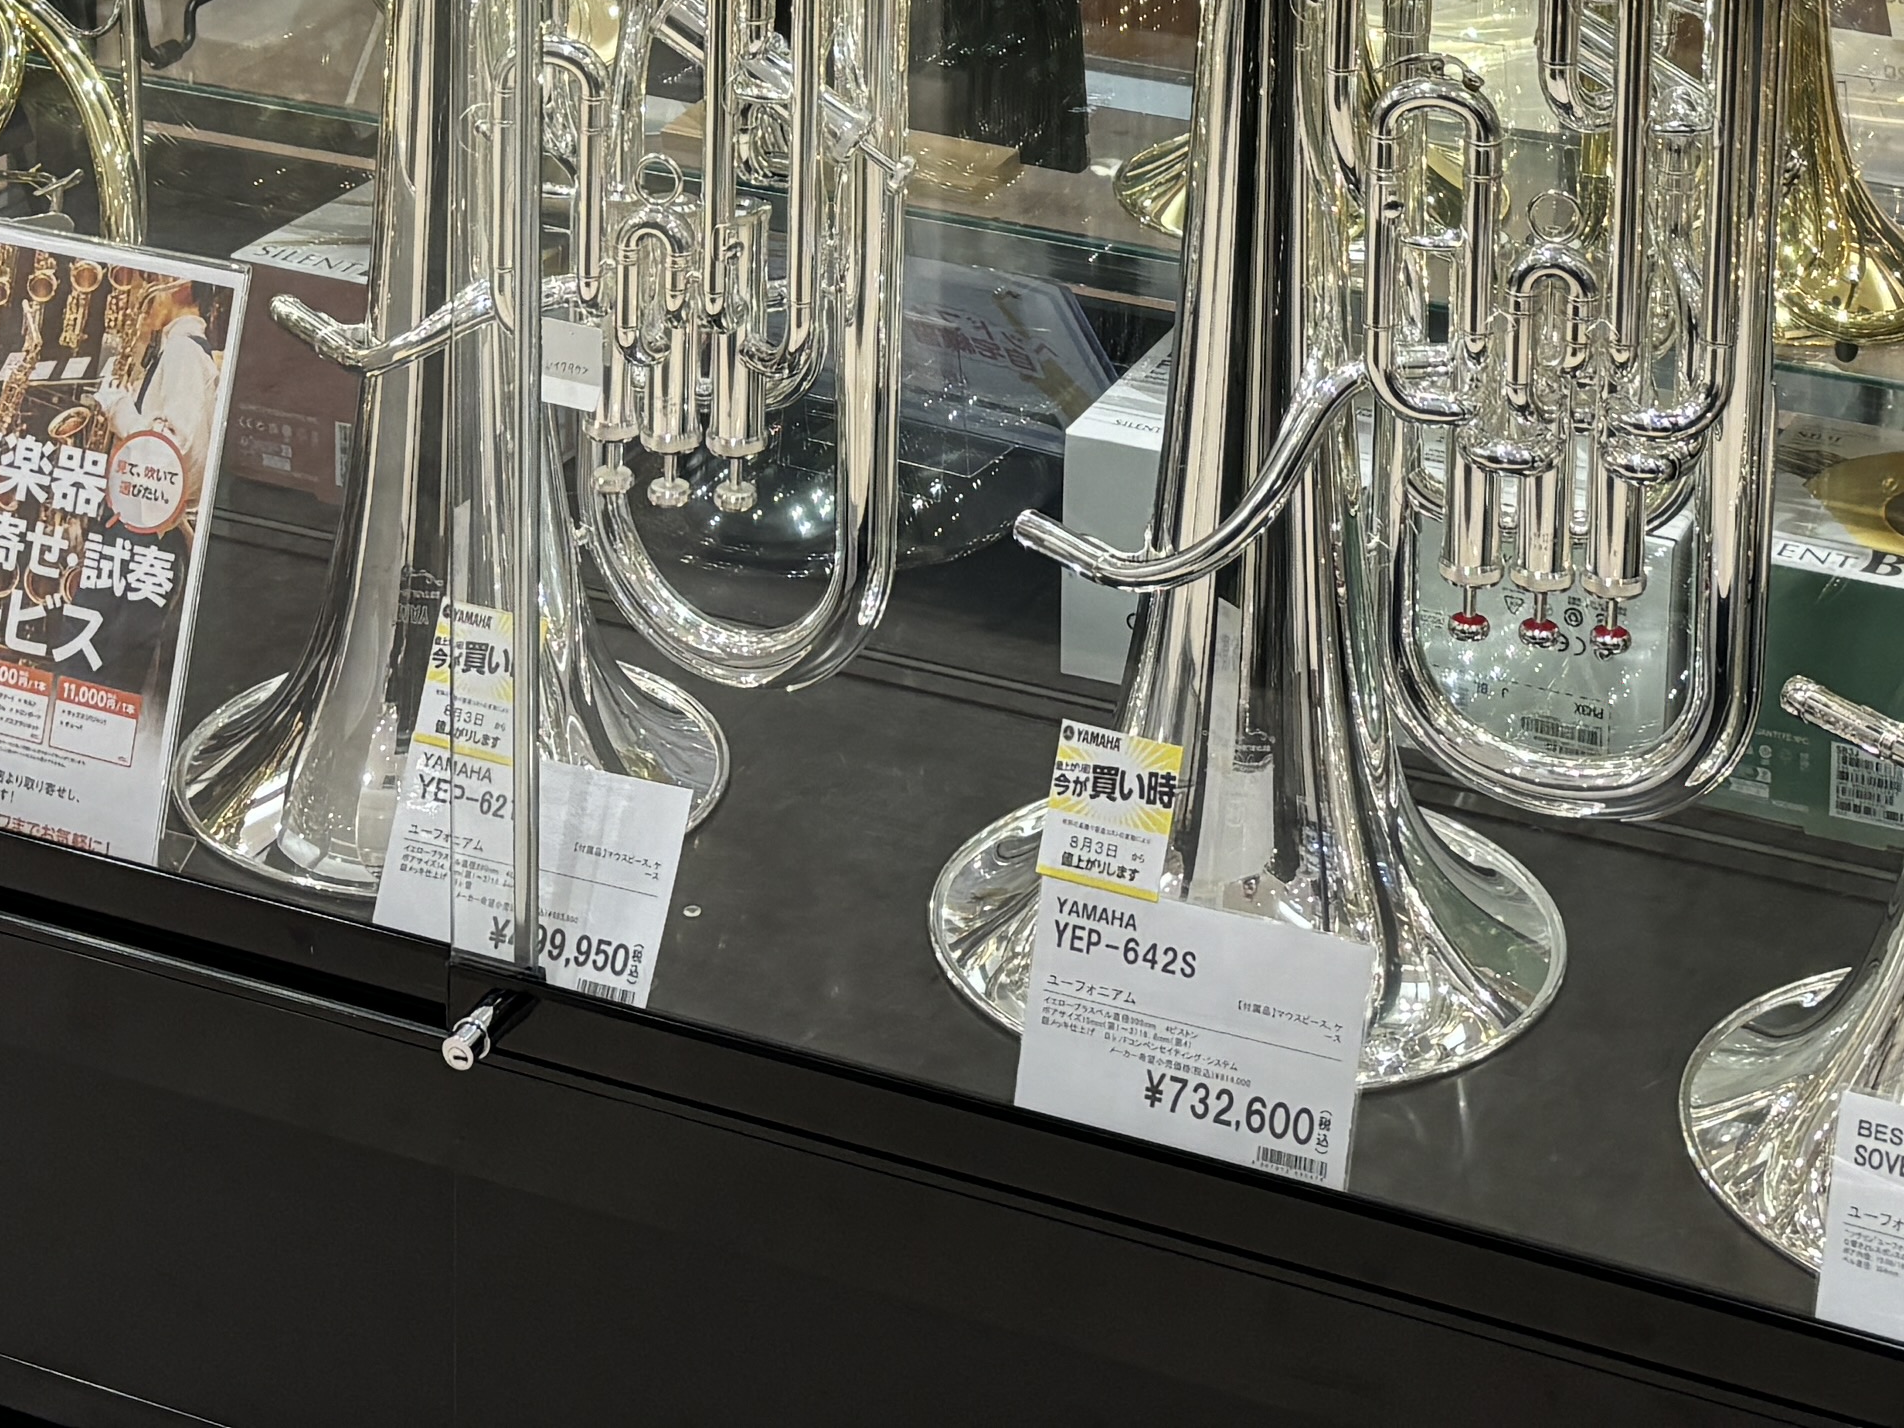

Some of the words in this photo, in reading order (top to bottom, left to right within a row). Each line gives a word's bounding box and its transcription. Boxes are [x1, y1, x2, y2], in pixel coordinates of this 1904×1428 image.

[114, 457, 179, 485] 見て、吹いて
[117, 479, 171, 505] 選びたい。
[1777, 544, 1858, 569] ENT
[452, 609, 494, 630] YAMAHA
[432, 641, 515, 675] 今が買い
[1076, 727, 1121, 751] YAMAHA
[423, 752, 493, 784] YAMAHA
[1053, 765, 1177, 809] 今が買い時
[408, 824, 484, 852] ユーフォニアム
[1069, 834, 1118, 859] 8月3日
[1061, 852, 1140, 882] 値上がりします
[1056, 896, 1138, 931] YAMAHA
[488, 915, 629, 977] ¥99,950
[1053, 920, 1197, 979] YEP-642S
[1047, 973, 1137, 1005] ユーフォニアム
[1143, 1069, 1314, 1145] ¥732,600
[1314, 1108, 1332, 1155] (税込)
